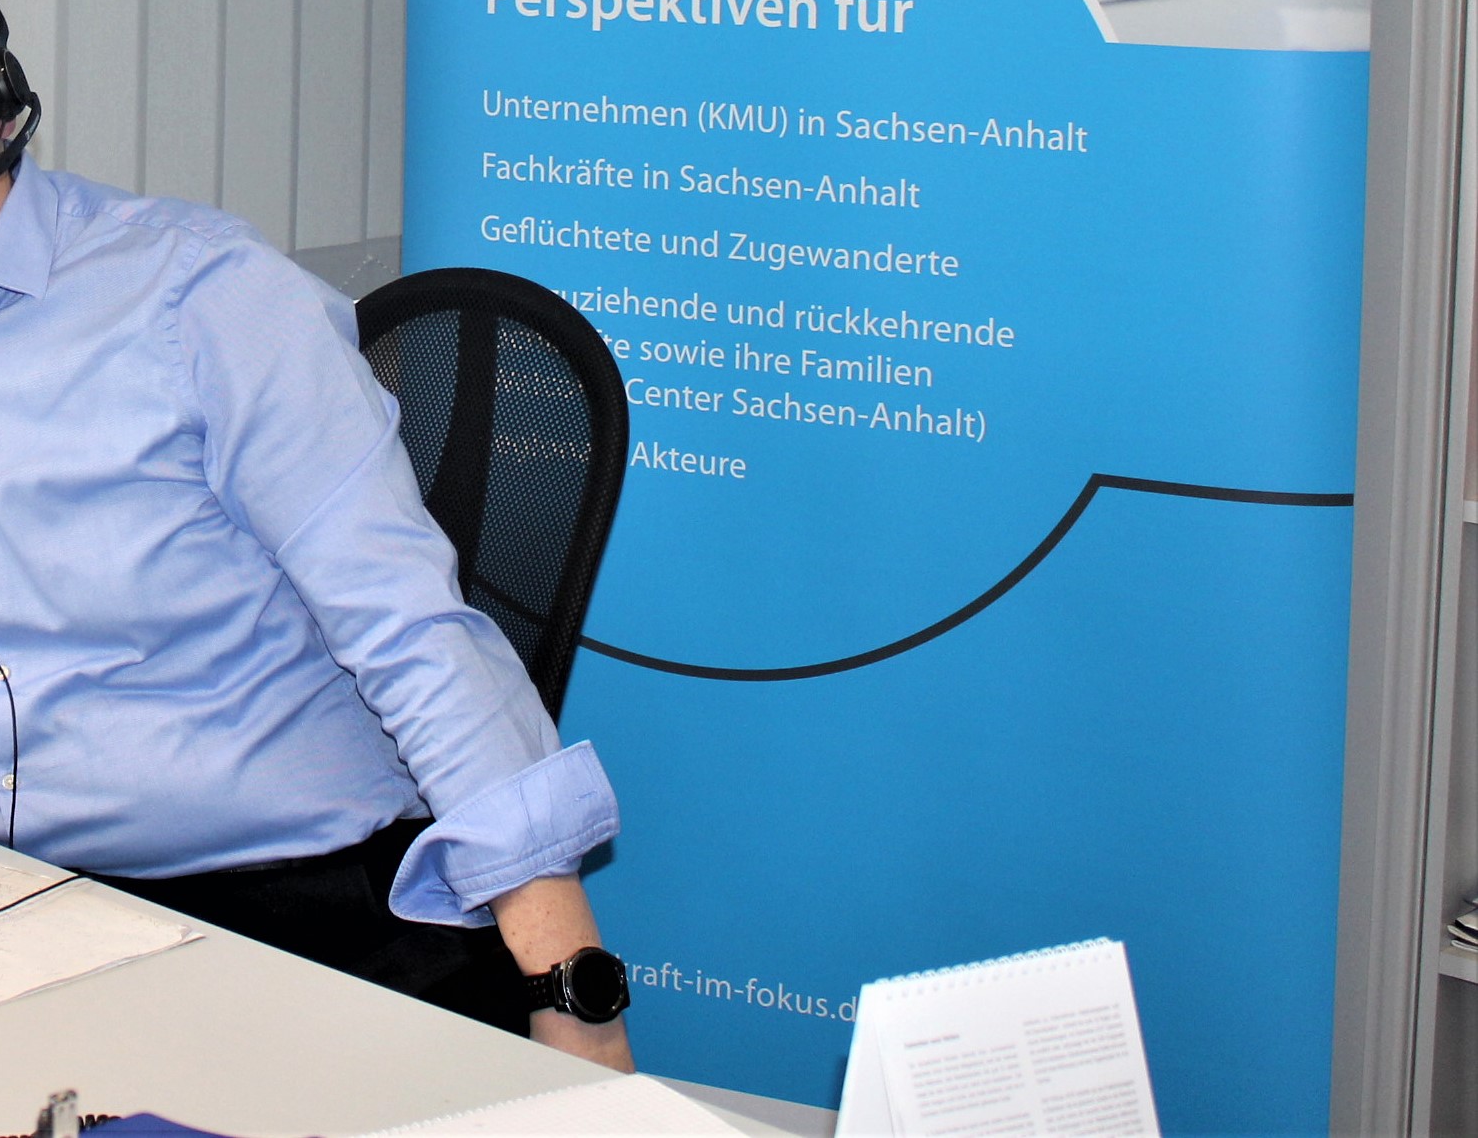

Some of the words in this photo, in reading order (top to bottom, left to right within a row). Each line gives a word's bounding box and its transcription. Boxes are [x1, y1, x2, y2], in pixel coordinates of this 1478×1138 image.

[483, 90, 688, 128] Unternehmen
[698, 101, 788, 138] (KMU)
[798, 108, 826, 137] in
[835, 110, 1089, 153] Sachsen-Anhalt
[482, 151, 634, 189] Fachkräfte
[643, 162, 670, 191] in
[679, 165, 921, 209] Sachsen-Anhalt
[480, 214, 652, 253] Geflüchtete
[661, 229, 719, 258] und
[727, 233, 960, 277] Zugewanderte
[551, 286, 718, 322] uziehende
[727, 300, 785, 329] und
[795, 305, 1016, 348] rückkehrende
[639, 339, 725, 368] sowie
[735, 342, 792, 375] ihre
[801, 350, 933, 388] Familien
[625, 377, 724, 413] Center
[732, 389, 987, 442] Sachsen-Anhalt)
[630, 441, 747, 479] Akteure
